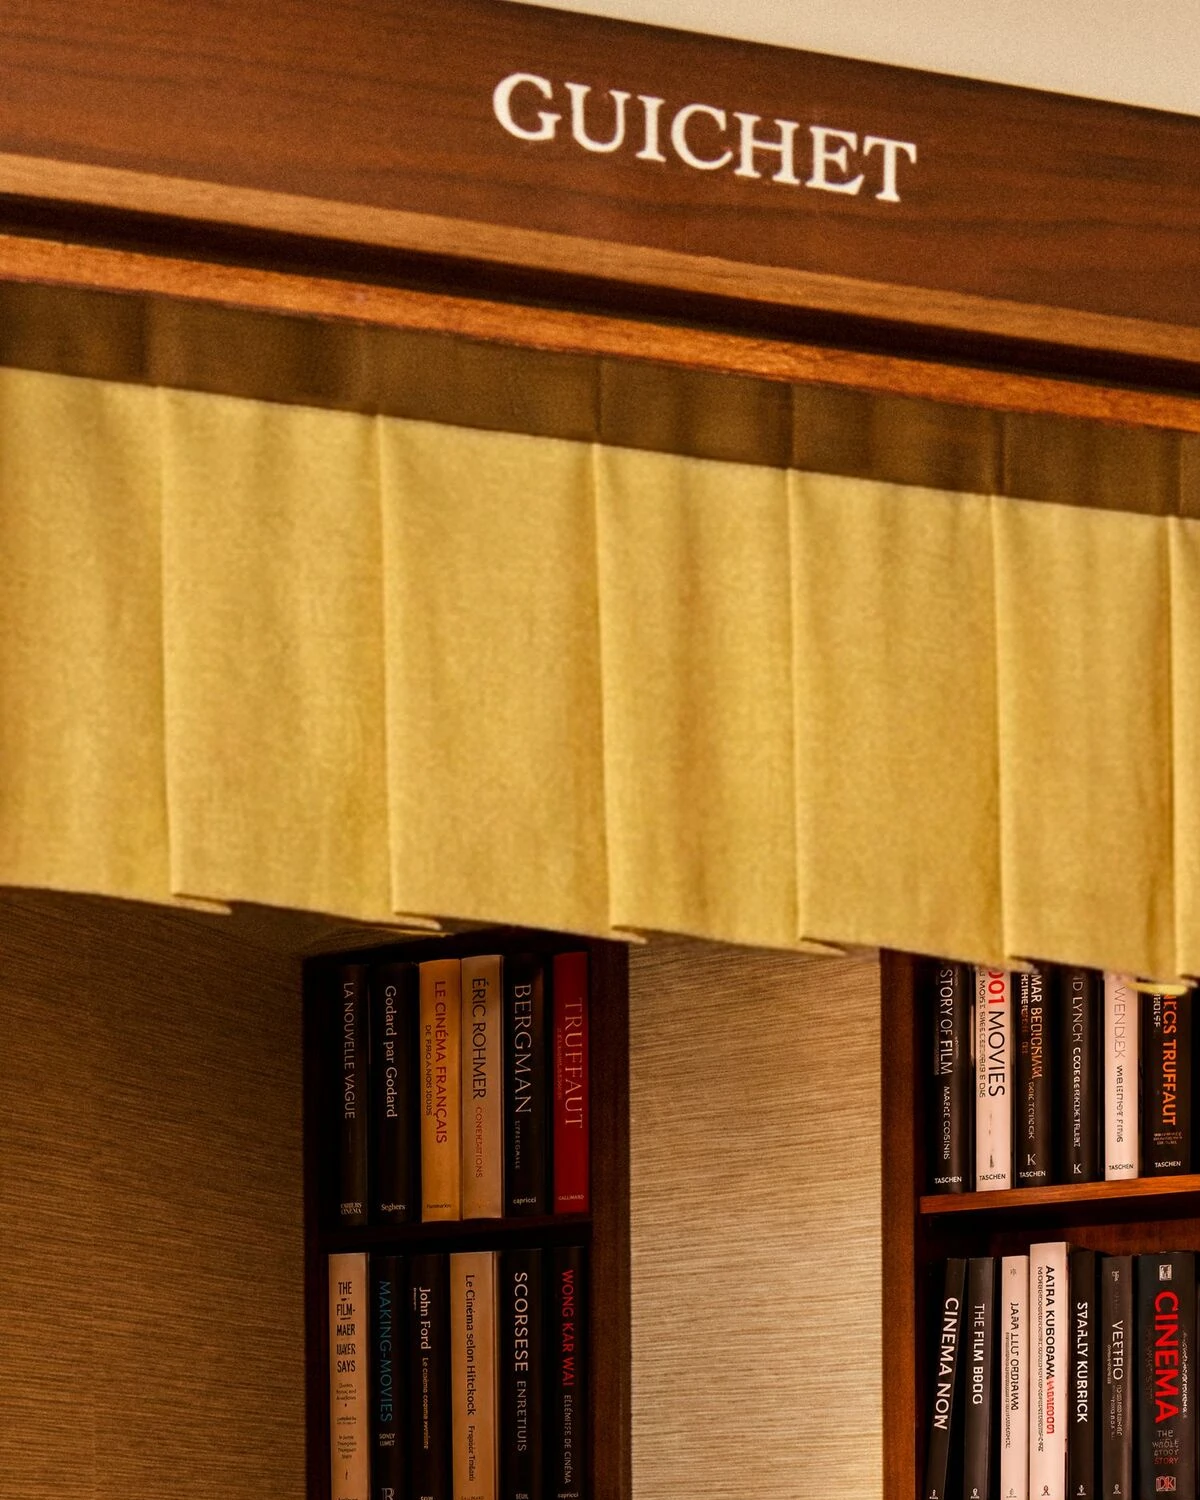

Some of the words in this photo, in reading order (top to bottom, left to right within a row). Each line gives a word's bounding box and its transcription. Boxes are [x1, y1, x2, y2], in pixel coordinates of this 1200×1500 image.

[493, 72, 917, 202] GUICHET
[344, 983, 354, 998] LA
[385, 985, 397, 1036] Godard
[435, 981, 446, 997] LE
[472, 979, 488, 1017] ÉRIC
[940, 969, 953, 1016] STORY
[344, 1002, 354, 1070] NOUVELLE
[435, 1002, 448, 1059] CINÉMA
[940, 1019, 953, 1035] OF
[1072, 997, 1083, 1042] LYNCH
[383, 1041, 395, 1063] par
[473, 1023, 486, 1099] ROHMER
[514, 984, 531, 1113] BERGMAN
[564, 998, 582, 1128] TRUFFAUT
[940, 1040, 953, 1075] FILM
[988, 1011, 1005, 1096] MOVIES
[344, 1074, 355, 1119] VAGUE
[386, 1066, 397, 1117] Godard
[434, 1066, 447, 1143] FRANÇAIS
[1162, 1040, 1176, 1125] TRUFFAUT
[338, 1281, 352, 1295] THE
[419, 1287, 431, 1316] John
[465, 1275, 475, 1287] Le
[561, 1270, 575, 1317] WONG
[466, 1290, 476, 1330] Cinéma
[514, 1272, 528, 1372] SCORSESE
[974, 1304, 985, 1327] THE
[379, 1281, 393, 1423] MAKING-MOVIES
[420, 1321, 431, 1350] Ford
[466, 1334, 475, 1362] selon
[562, 1323, 575, 1352] KAR
[938, 1297, 959, 1376] CINEMA
[973, 1331, 984, 1361] FILM
[1154, 1290, 1179, 1423] CINEMA
[337, 1360, 356, 1373] SAYS
[562, 1357, 575, 1386] WAI
[933, 1383, 952, 1430] NOW
[564, 1452, 574, 1484] CINÉMA
